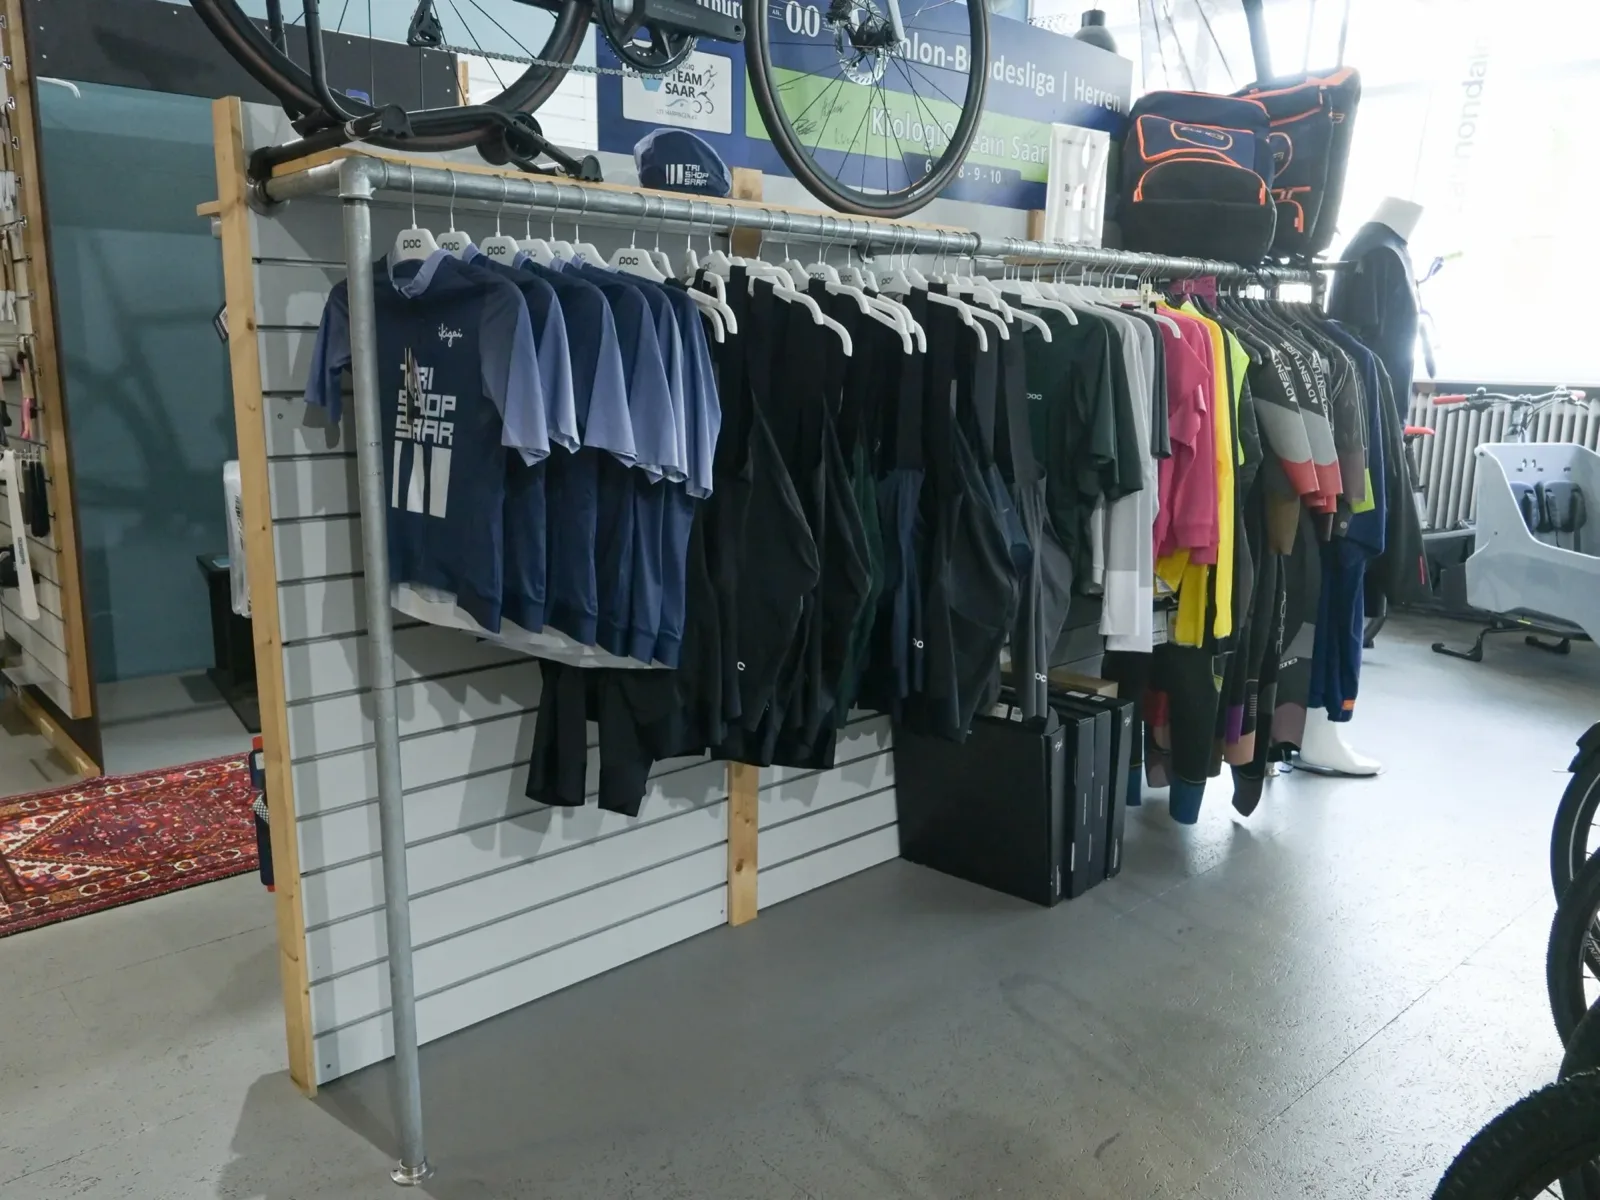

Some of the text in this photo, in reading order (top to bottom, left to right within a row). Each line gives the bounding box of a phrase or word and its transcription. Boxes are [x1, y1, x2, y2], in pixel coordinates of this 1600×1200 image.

[785, 1, 820, 38] 0.0
[665, 82, 696, 98] SAAR
[1074, 76, 1120, 113] Herren
[970, 135, 1004, 157] eam
[1011, 136, 1047, 164] Saar
[685, 171, 709, 179] SHOP
[990, 170, 1002, 185] 10
[438, 323, 463, 348] ikigai
[395, 415, 454, 446] SAAR
